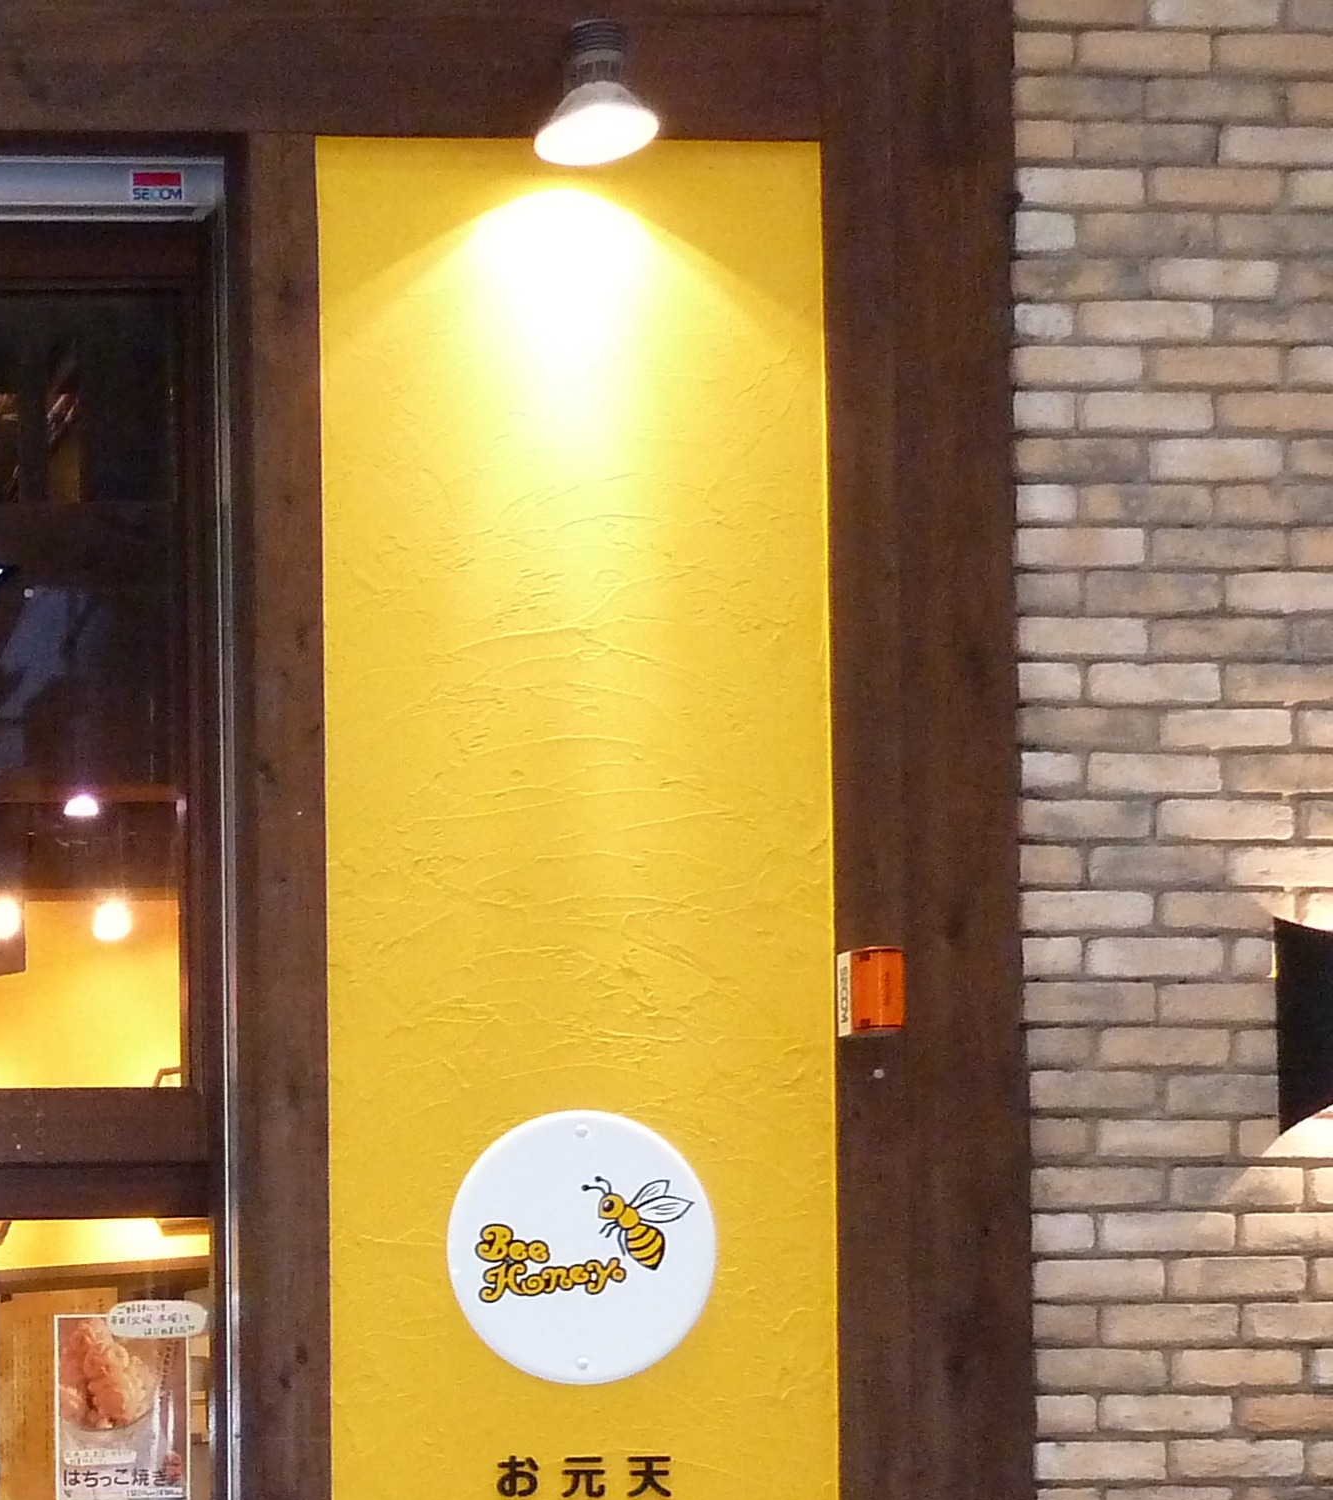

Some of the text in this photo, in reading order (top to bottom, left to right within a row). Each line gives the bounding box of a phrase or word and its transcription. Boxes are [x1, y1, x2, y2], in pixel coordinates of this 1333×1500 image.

[133, 188, 182, 200] SECOM
[839, 966, 849, 1024] SECOM
[475, 1224, 550, 1262] Bee
[478, 1258, 621, 1303] Honey
